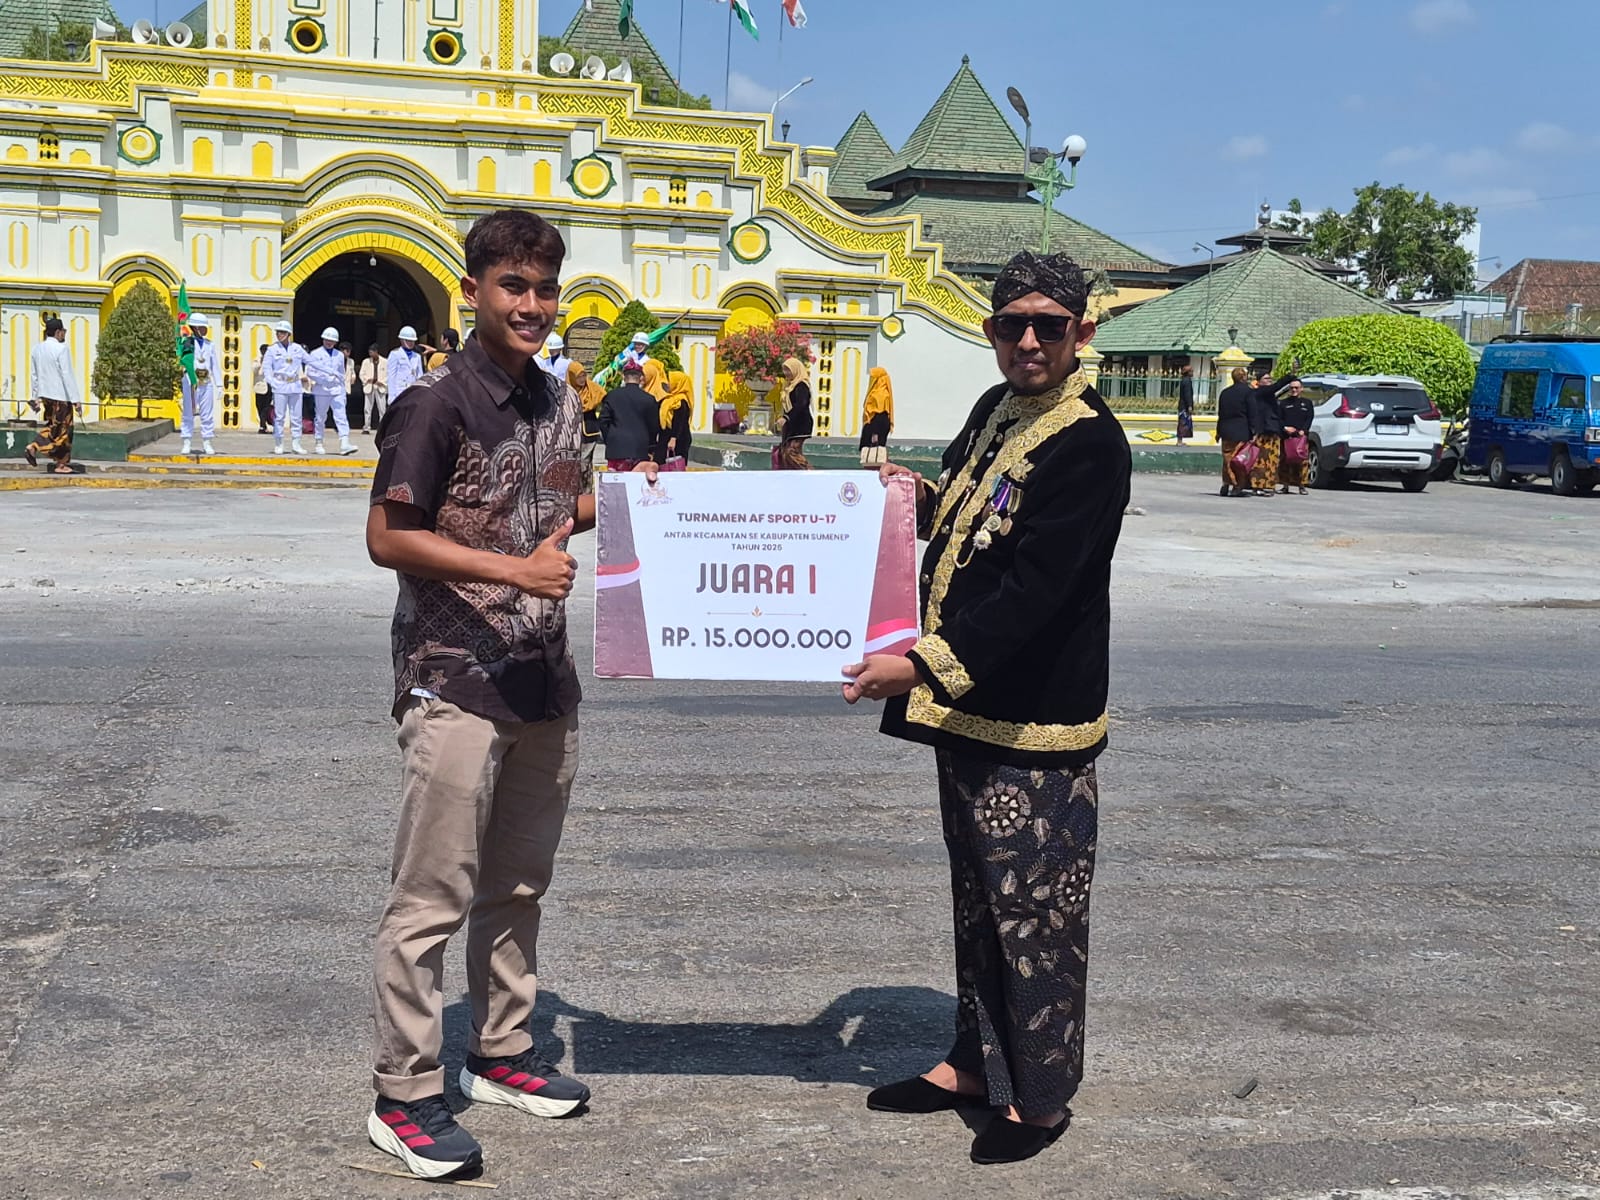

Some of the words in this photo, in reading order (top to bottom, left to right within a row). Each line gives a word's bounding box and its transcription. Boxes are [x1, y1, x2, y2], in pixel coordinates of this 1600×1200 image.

[677, 512, 747, 523] TURNAMEN
[749, 513, 765, 523] AF
[767, 513, 807, 524] SPORT
[809, 514, 837, 524] U-17
[664, 531, 692, 539] ANTAR
[694, 531, 747, 540] KECAMATAN
[748, 532, 759, 540] SE
[760, 532, 809, 541] KABUPATEN
[811, 533, 850, 541] SUMENEP
[731, 543, 760, 551] TAHUN
[696, 562, 795, 595] JUARA
[809, 564, 817, 595] I
[661, 626, 697, 647] RP.
[704, 627, 852, 650] 15.000.000
